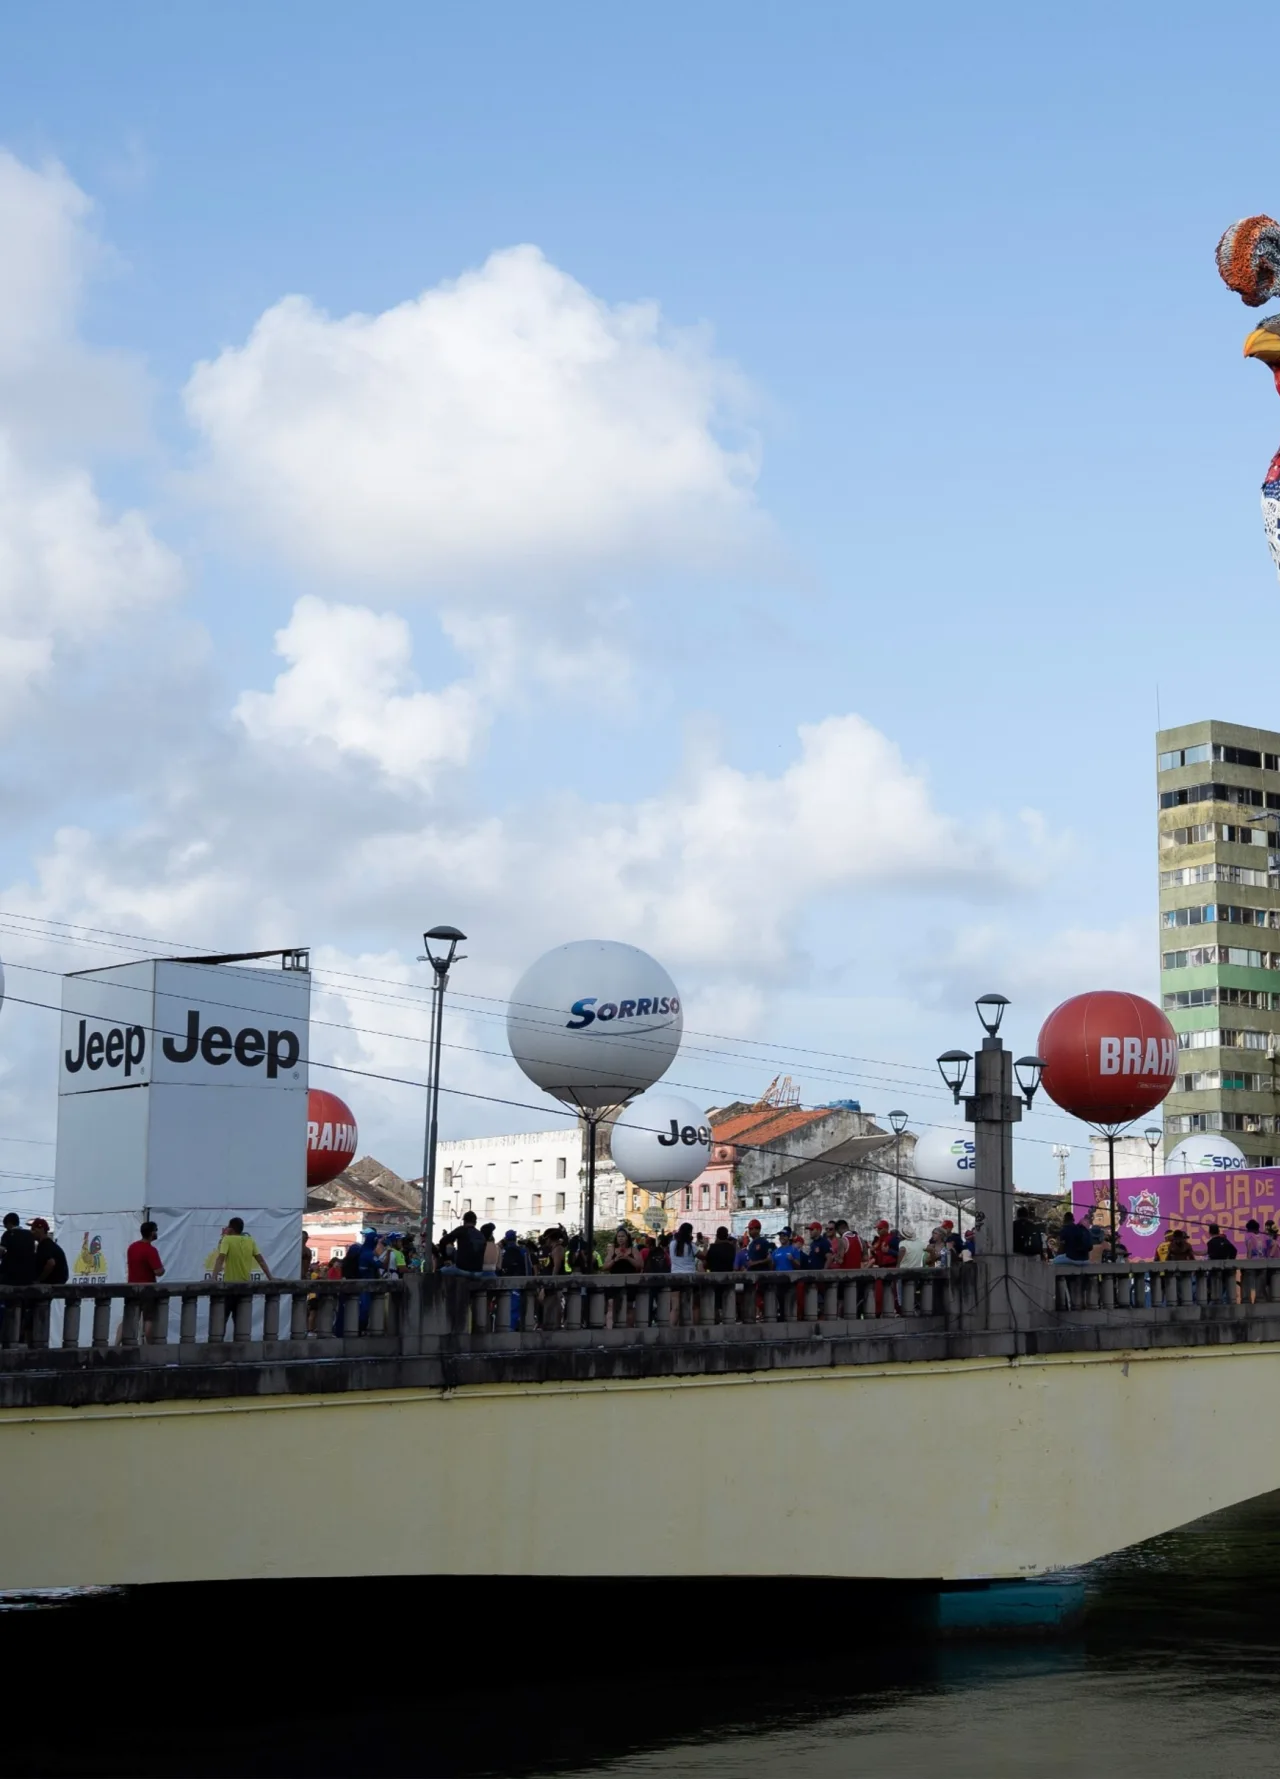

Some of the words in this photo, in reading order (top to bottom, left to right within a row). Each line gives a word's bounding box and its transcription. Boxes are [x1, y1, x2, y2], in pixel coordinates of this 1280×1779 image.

[65, 1019, 145, 1077] Jeep
[162, 1010, 300, 1079] Jeep
[1255, 1178, 1275, 1197] DE
